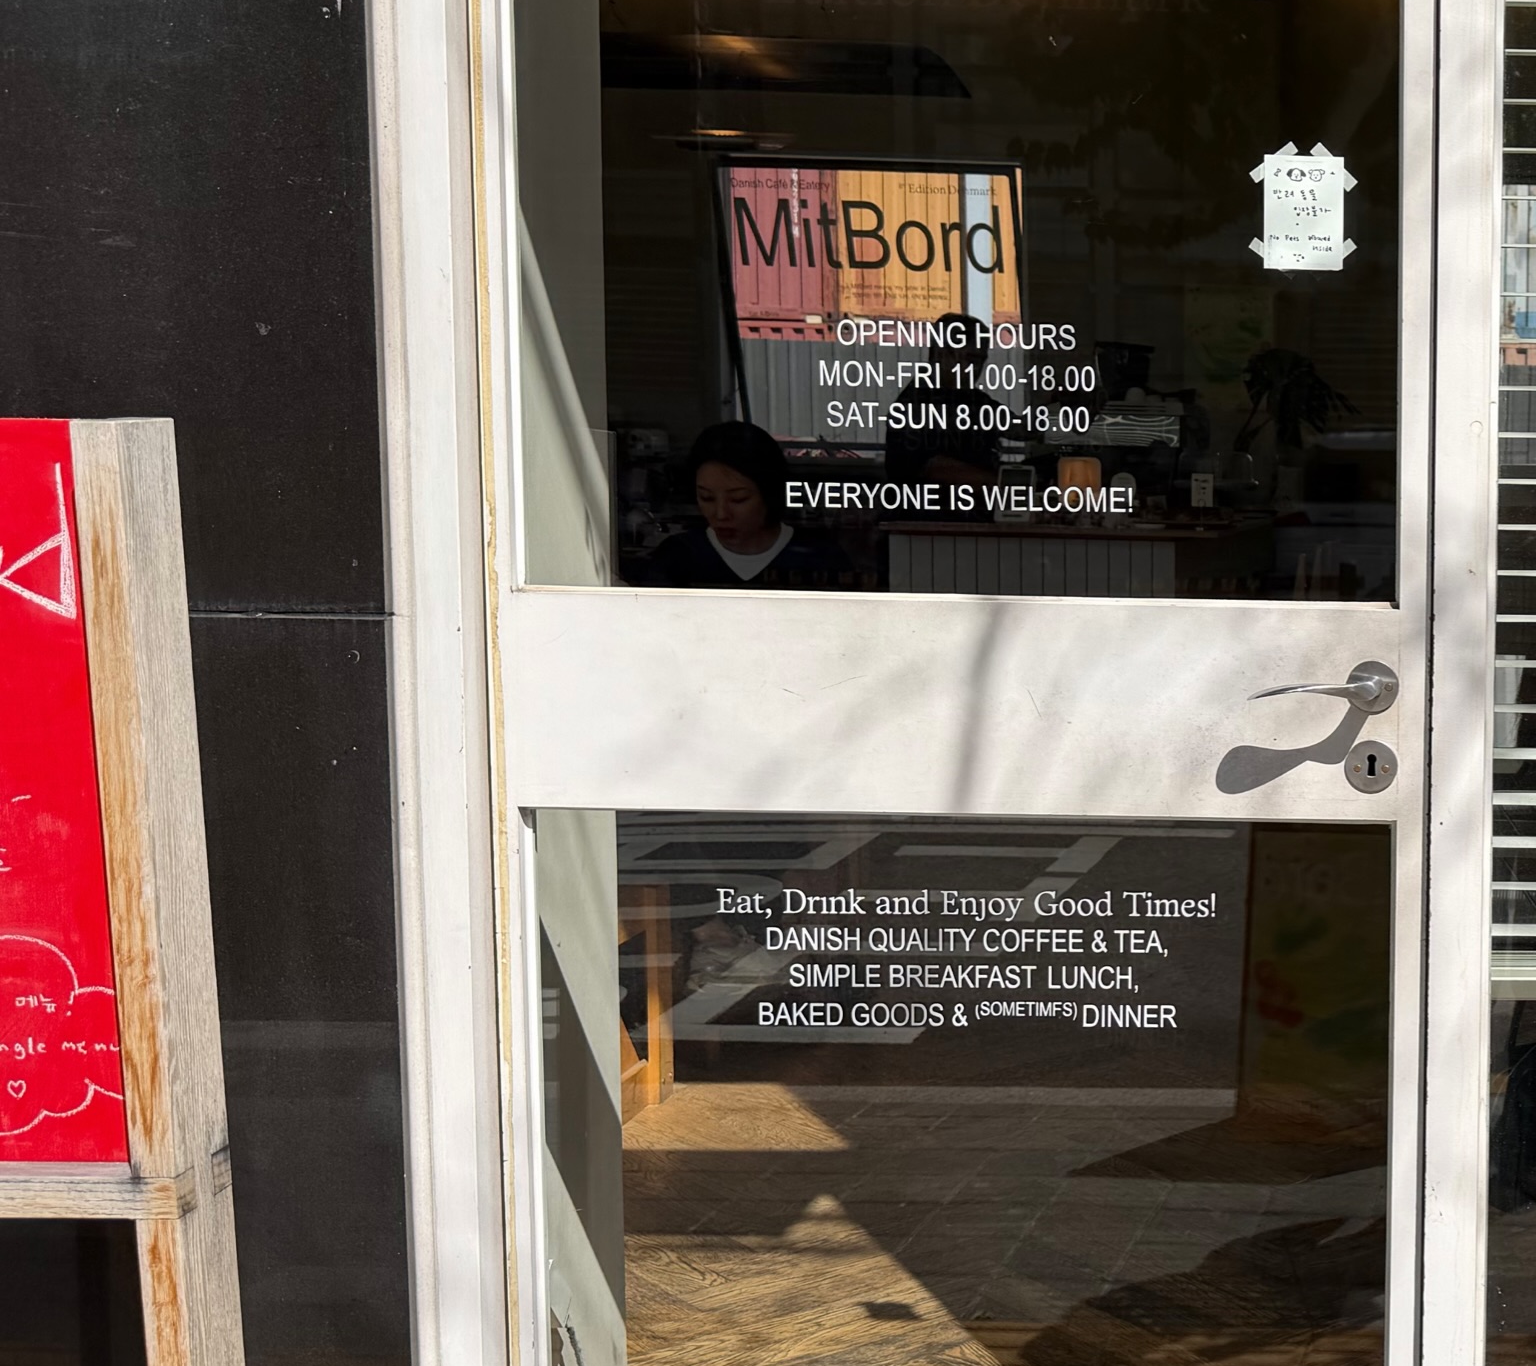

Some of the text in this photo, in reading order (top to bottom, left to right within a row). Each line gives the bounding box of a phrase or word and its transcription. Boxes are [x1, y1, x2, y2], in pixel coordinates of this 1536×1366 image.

[908, 183, 946, 195] Edition
[733, 196, 1005, 275] MitBord
[836, 319, 1077, 352] OPENING HOURS
[818, 359, 1097, 393] MON-FRI 11.00-18.00
[826, 401, 1091, 434] SAT-SUN 8.00-18.00
[784, 480, 1135, 515] EVERYONE IS WELCOME!
[715, 887, 1217, 923] Eat, Drink and Enjoy Good Times!
[765, 926, 1169, 958] DANISH QUALITY COFFEE & TEA,
[788, 963, 1140, 993] SIMPLE BREAKFAST LUNCH,
[757, 1002, 843, 1026] BAKED
[850, 1002, 944, 1027] GOODS
[951, 1003, 969, 1027] &
[1081, 1003, 1178, 1029] DINNER
